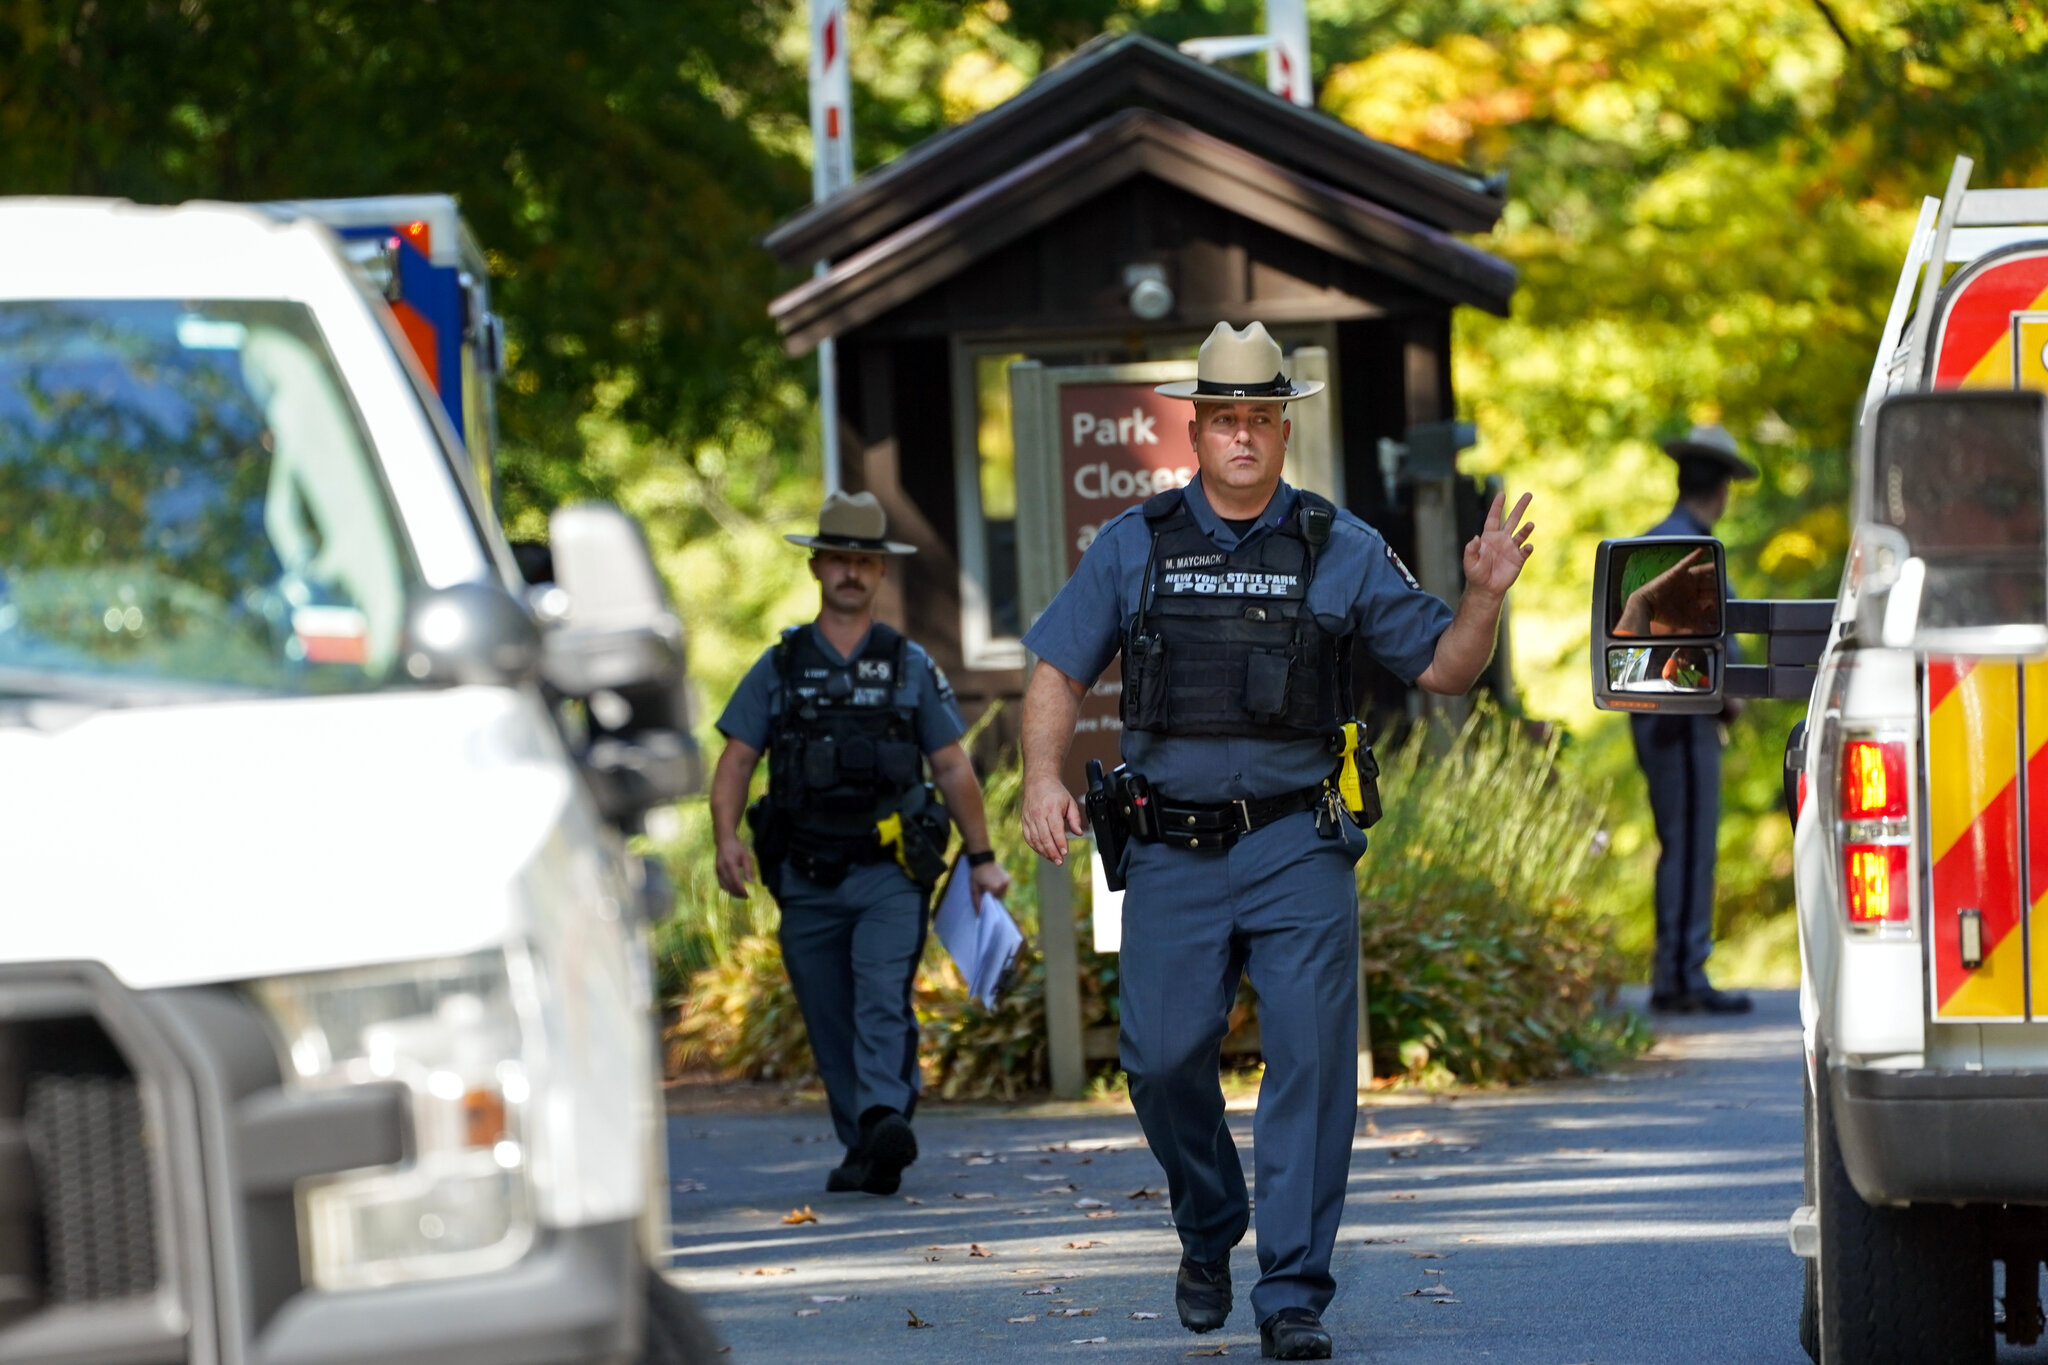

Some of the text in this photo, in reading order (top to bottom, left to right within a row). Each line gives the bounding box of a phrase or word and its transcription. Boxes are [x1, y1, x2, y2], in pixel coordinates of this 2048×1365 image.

[1072, 407, 1158, 446] Park
[1073, 462, 1193, 499] Closes
[1165, 554, 1222, 570] M. MAYCHACK
[1165, 573, 1297, 586] NEW YORK STATE PARK
[1173, 582, 1288, 595] POLICE
[858, 661, 890, 680] K-9
